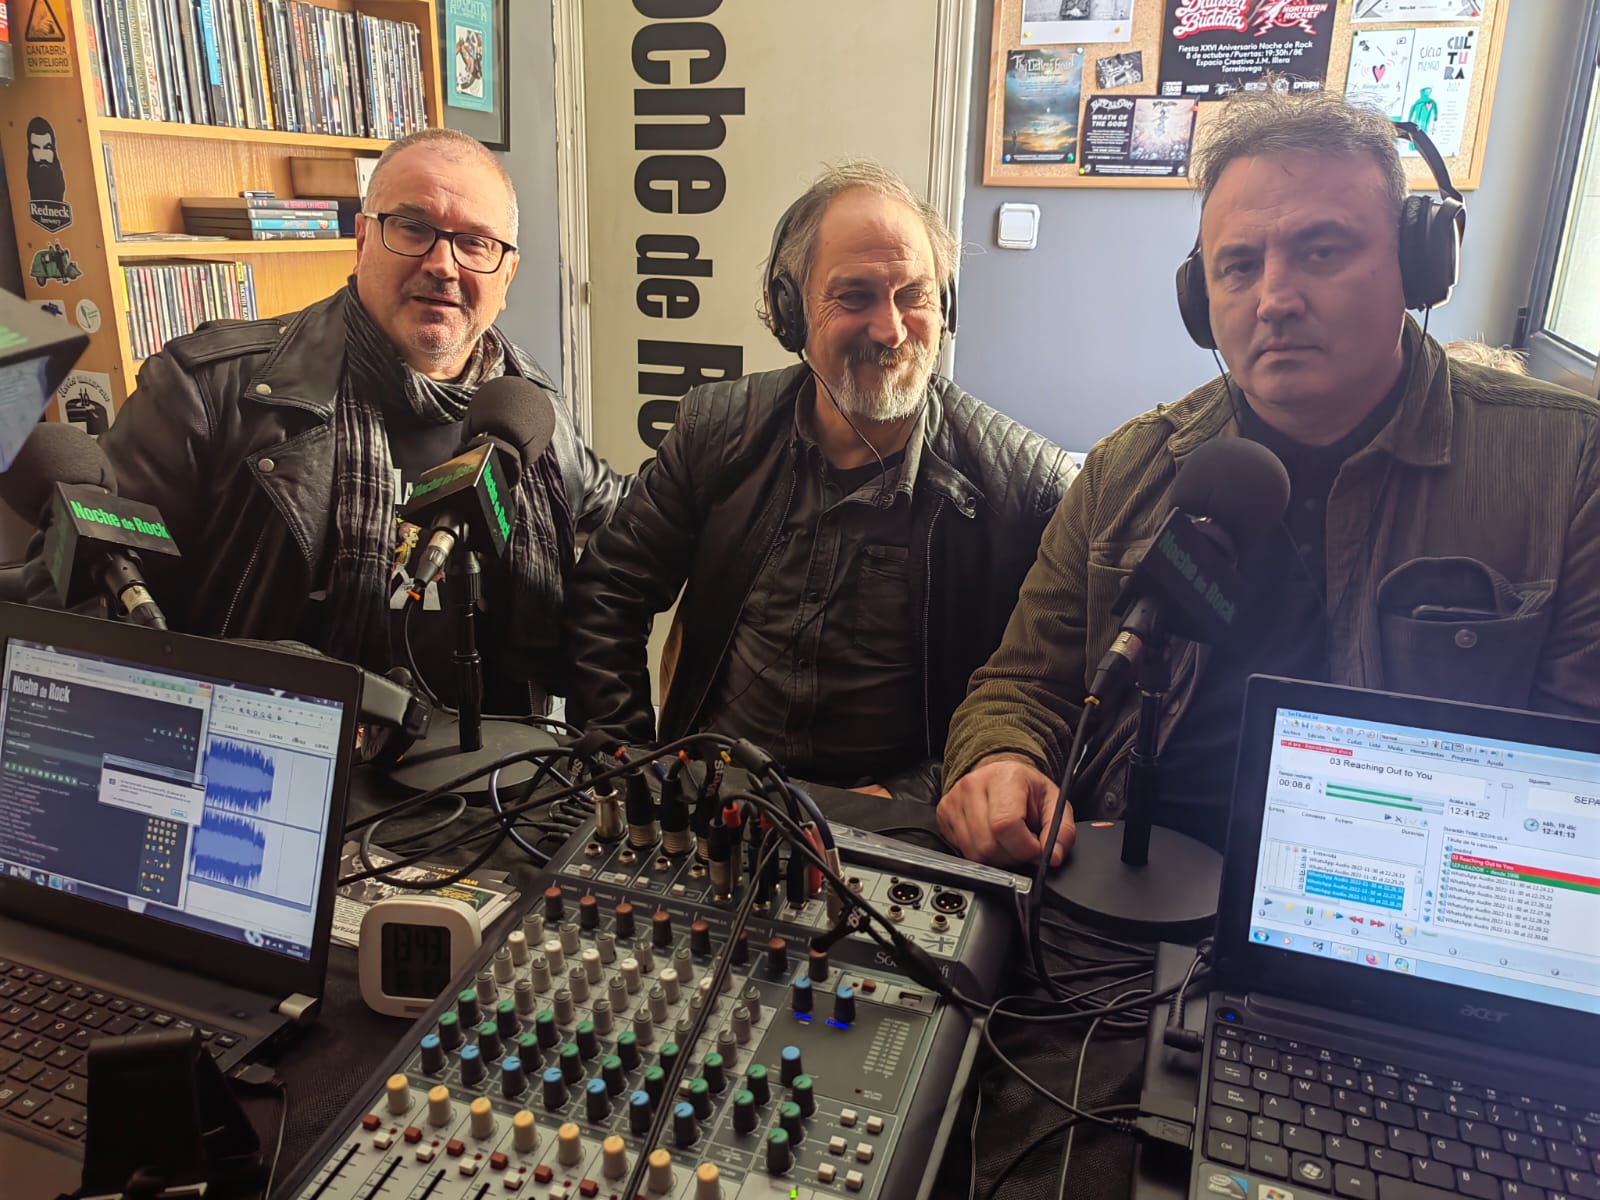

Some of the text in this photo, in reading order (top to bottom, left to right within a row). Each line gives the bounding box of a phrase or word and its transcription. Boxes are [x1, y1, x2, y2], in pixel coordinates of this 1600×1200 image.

[1283, 4, 1328, 13] NORTHERN
[1284, 11, 1319, 20] ROCKET
[1173, 9, 1246, 36] Buddha
[26, 45, 67, 56] CANTABRIA
[1178, 40, 1313, 53] Fiesta XXVI Aniversario Noche de Rock
[1192, 51, 1201, 60] de
[28, 58, 69, 67] EN PELIGRO
[1196, 59, 1223, 67] Espacio
[1224, 58, 1255, 66] Creativo
[1222, 65, 1263, 74] Torrelavega
[1107, 120, 1128, 128] GODS
[30, 203, 70, 218] Redneck
[635, 234, 713, 320] de
[70, 500, 172, 540] Noche de Rock
[12, 674, 39, 697] Noche
[48, 682, 71, 704] Rock
[1329, 757, 1433, 782] 03 Reaching Out to You
[1450, 806, 1491, 821] 12:41:22
[1542, 828, 1576, 840] 12:41:13
[1460, 855, 1484, 867] Reaching
[1460, 1004, 1509, 1022] acer
